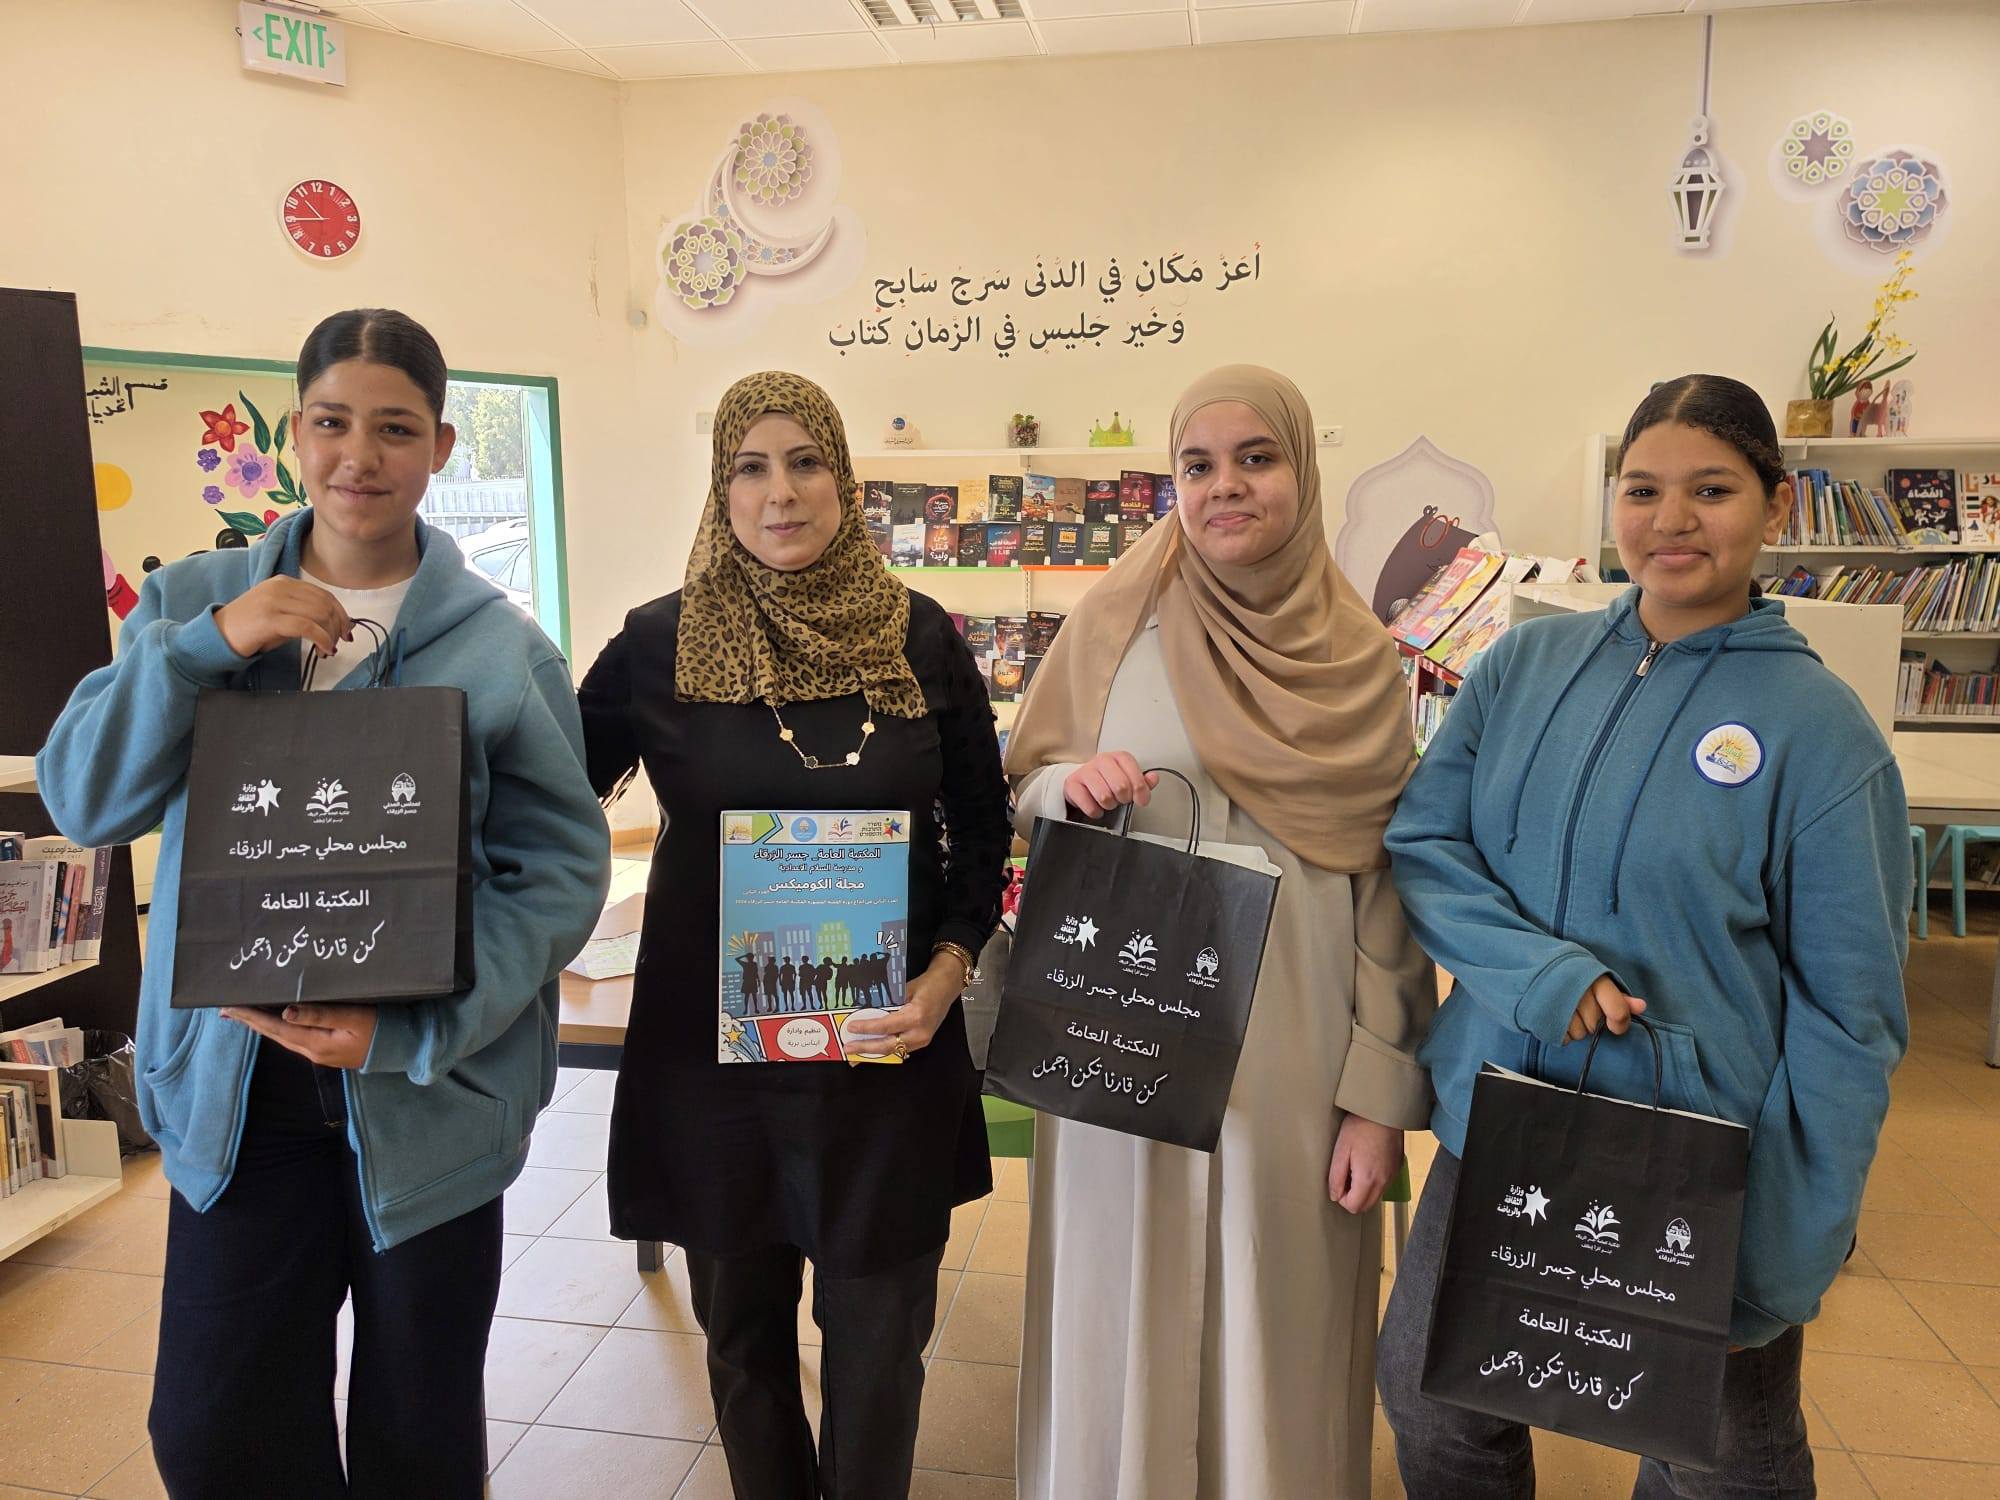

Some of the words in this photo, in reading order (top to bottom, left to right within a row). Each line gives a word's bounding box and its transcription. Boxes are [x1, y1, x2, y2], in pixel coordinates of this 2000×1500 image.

[264, 13, 328, 69] EXIT
[296, 184, 308, 198] 11
[310, 182, 323, 193] 12
[286, 196, 299, 209] 10
[323, 244, 332, 256] 6
[124, 378, 168, 410] قسم
[229, 839, 272, 859] الزرقاء
[276, 844, 311, 859] جسر
[316, 837, 354, 860] محلي
[359, 834, 407, 854] مجلس
[754, 848, 783, 861] الزرقاء
[848, 848, 881, 859] المكتبة
[785, 851, 809, 862] جسر
[768, 877, 832, 892] الكوميكس
[835, 877, 865, 891] مجلة
[261, 892, 309, 910] العامة
[315, 889, 369, 912] المكتبة
[276, 926, 309, 967] تكن
[353, 920, 385, 964] كن
[1046, 968, 1084, 989] الزرقاء
[1086, 985, 1117, 999] جسر
[1121, 988, 1155, 1007] محلي
[1159, 1000, 1200, 1018] مجلس
[1067, 1022, 1108, 1044] العامة
[1113, 1034, 1159, 1057] المكتبة
[1072, 1057, 1102, 1087] تكن
[1136, 1074, 1168, 1104] كن
[1491, 1245, 1536, 1269] الزرقاء
[1539, 1263, 1576, 1276] جسر
[1581, 1267, 1621, 1289] محلي
[1626, 1280, 1675, 1302] مجلس
[1519, 1308, 1568, 1335] العامة
[1575, 1322, 1631, 1351] المكتبة
[1528, 1352, 1564, 1388] تكن
[1608, 1371, 1644, 1410] كن
